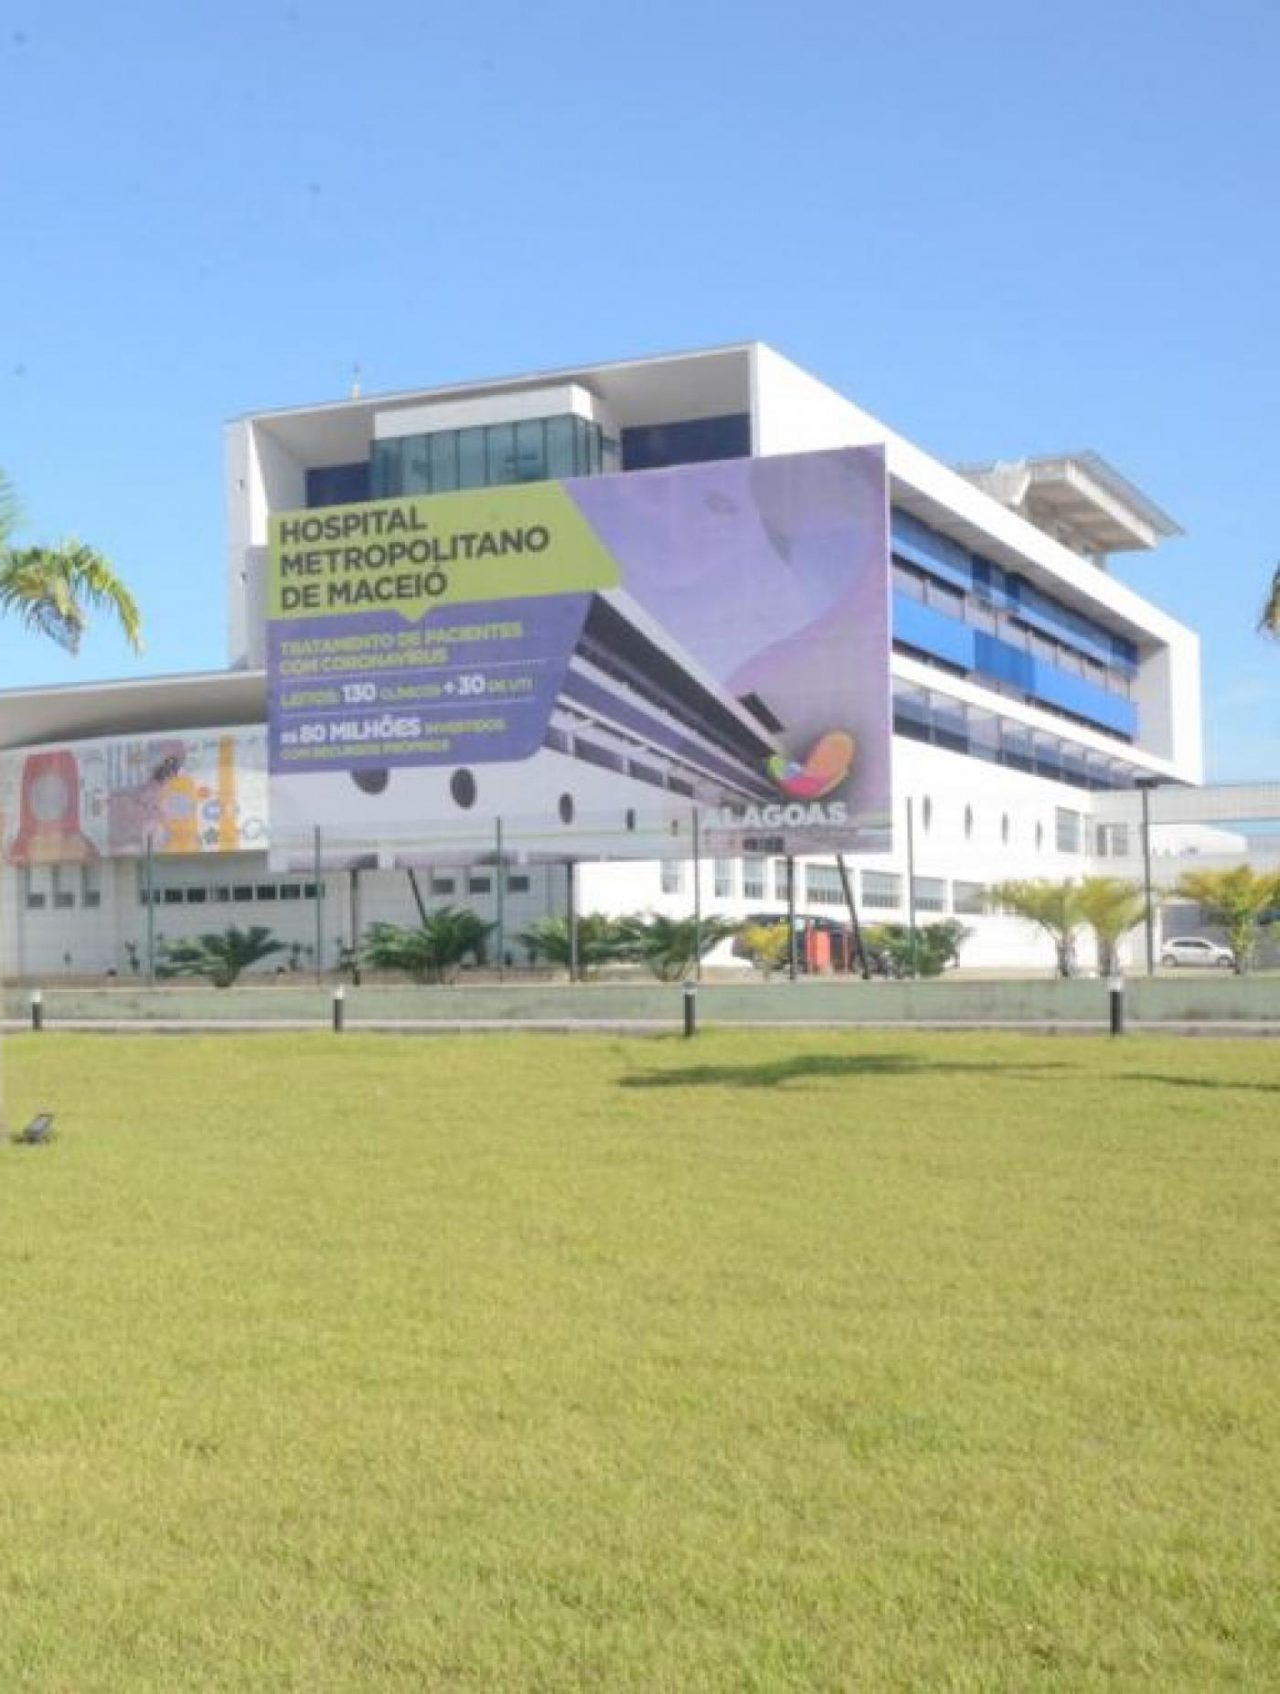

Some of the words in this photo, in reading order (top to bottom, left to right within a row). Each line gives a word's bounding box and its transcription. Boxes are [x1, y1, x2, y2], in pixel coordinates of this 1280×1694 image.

[279, 505, 427, 546] HOSPITAL
[280, 526, 551, 577] METROPOLITANO
[281, 584, 321, 610] DE
[327, 565, 448, 607] MACEIÓ
[702, 802, 848, 828] ALAGOAS
